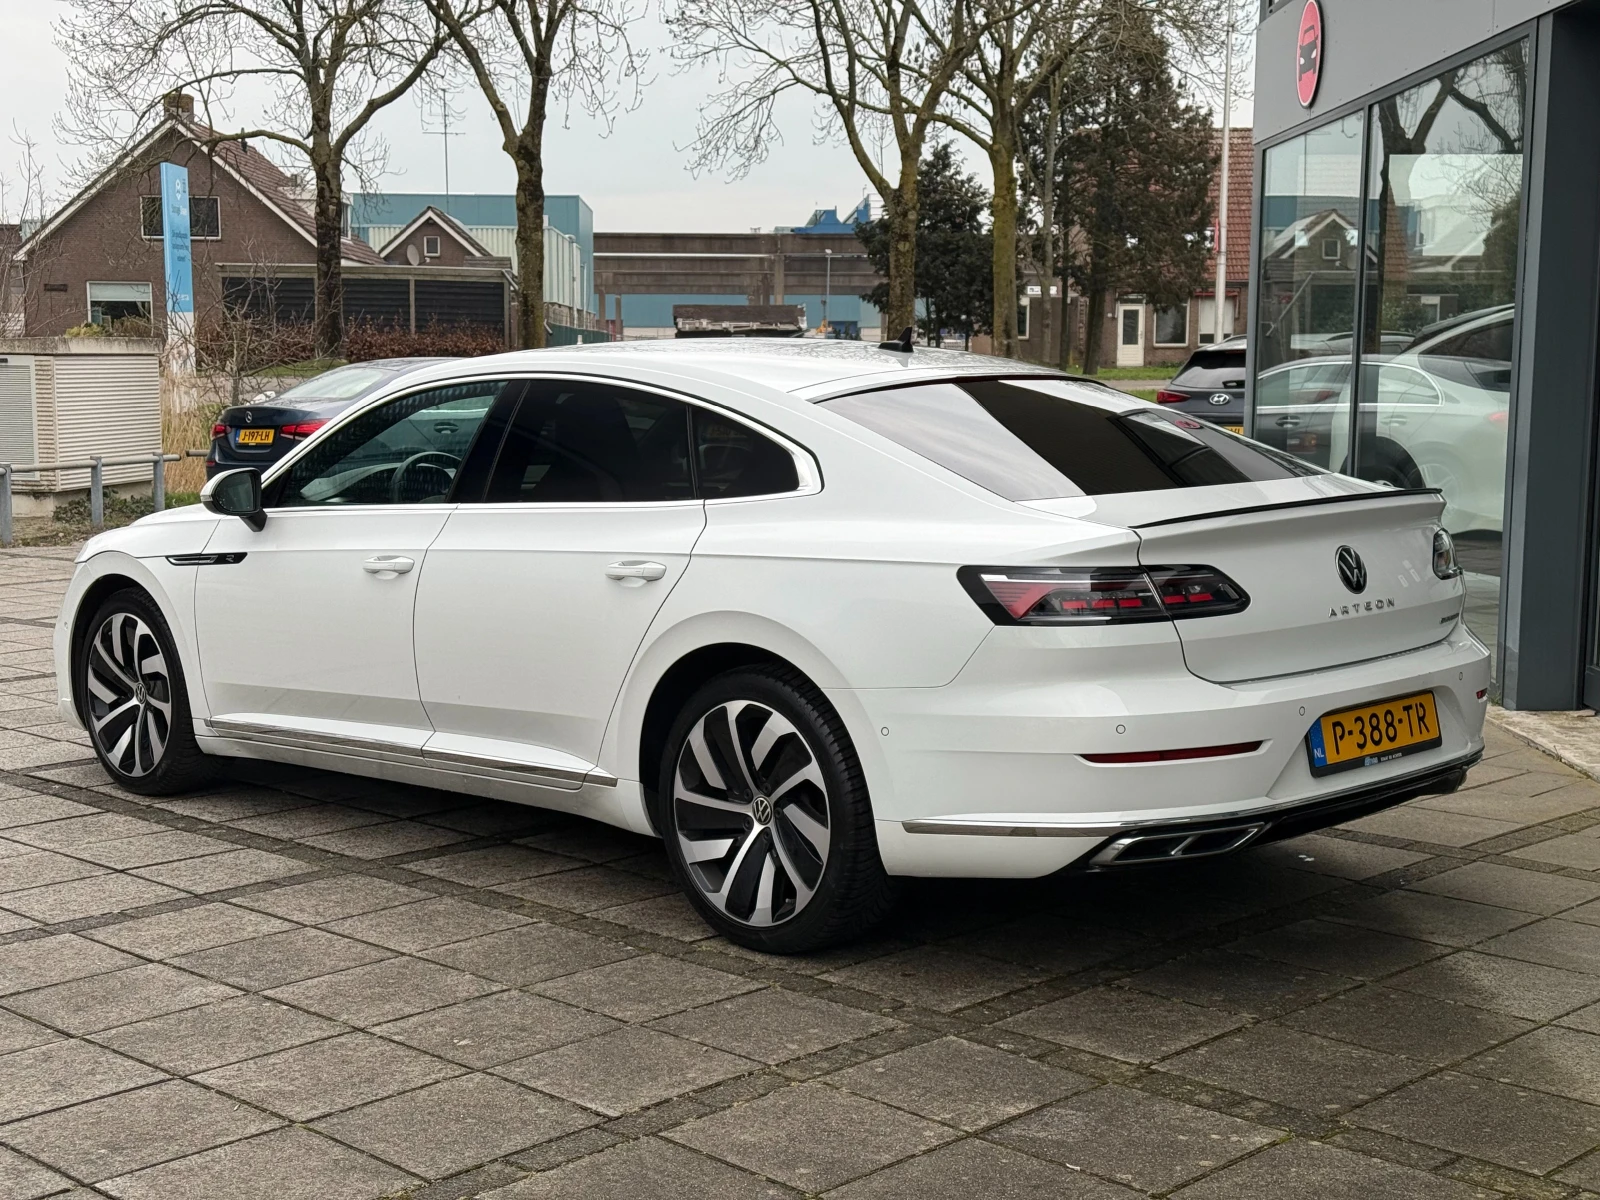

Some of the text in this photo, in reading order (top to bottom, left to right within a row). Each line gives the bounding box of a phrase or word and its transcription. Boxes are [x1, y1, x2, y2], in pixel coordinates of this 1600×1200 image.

[241, 430, 271, 442] J-197-LH
[1328, 598, 1396, 618] ARTEON
[1331, 701, 1431, 756] P-388-TR
[1313, 747, 1325, 759] NL
